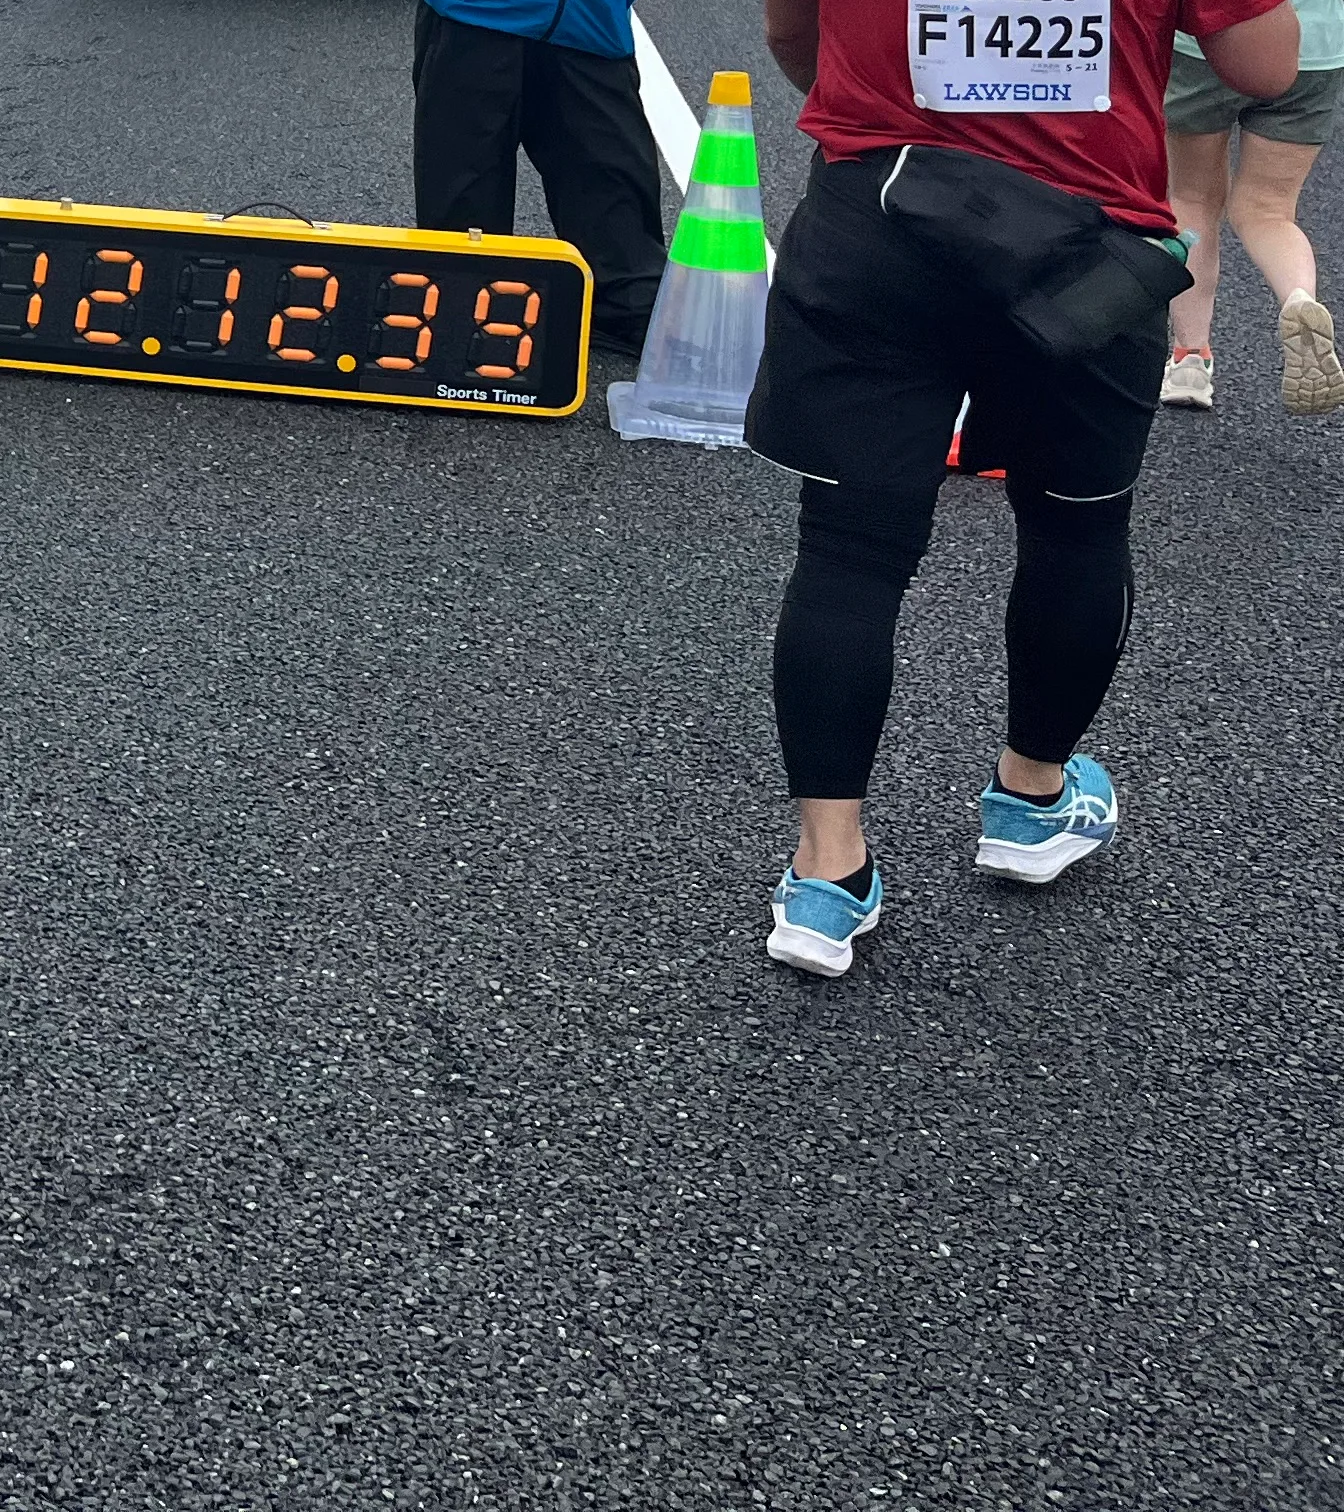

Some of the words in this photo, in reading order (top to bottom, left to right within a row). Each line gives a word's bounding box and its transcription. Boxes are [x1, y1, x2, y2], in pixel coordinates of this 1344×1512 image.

[918, 12, 1103, 58] F14225
[943, 83, 1072, 101] LAWSON
[436, 384, 488, 401] Sports
[492, 388, 538, 405] Timer
